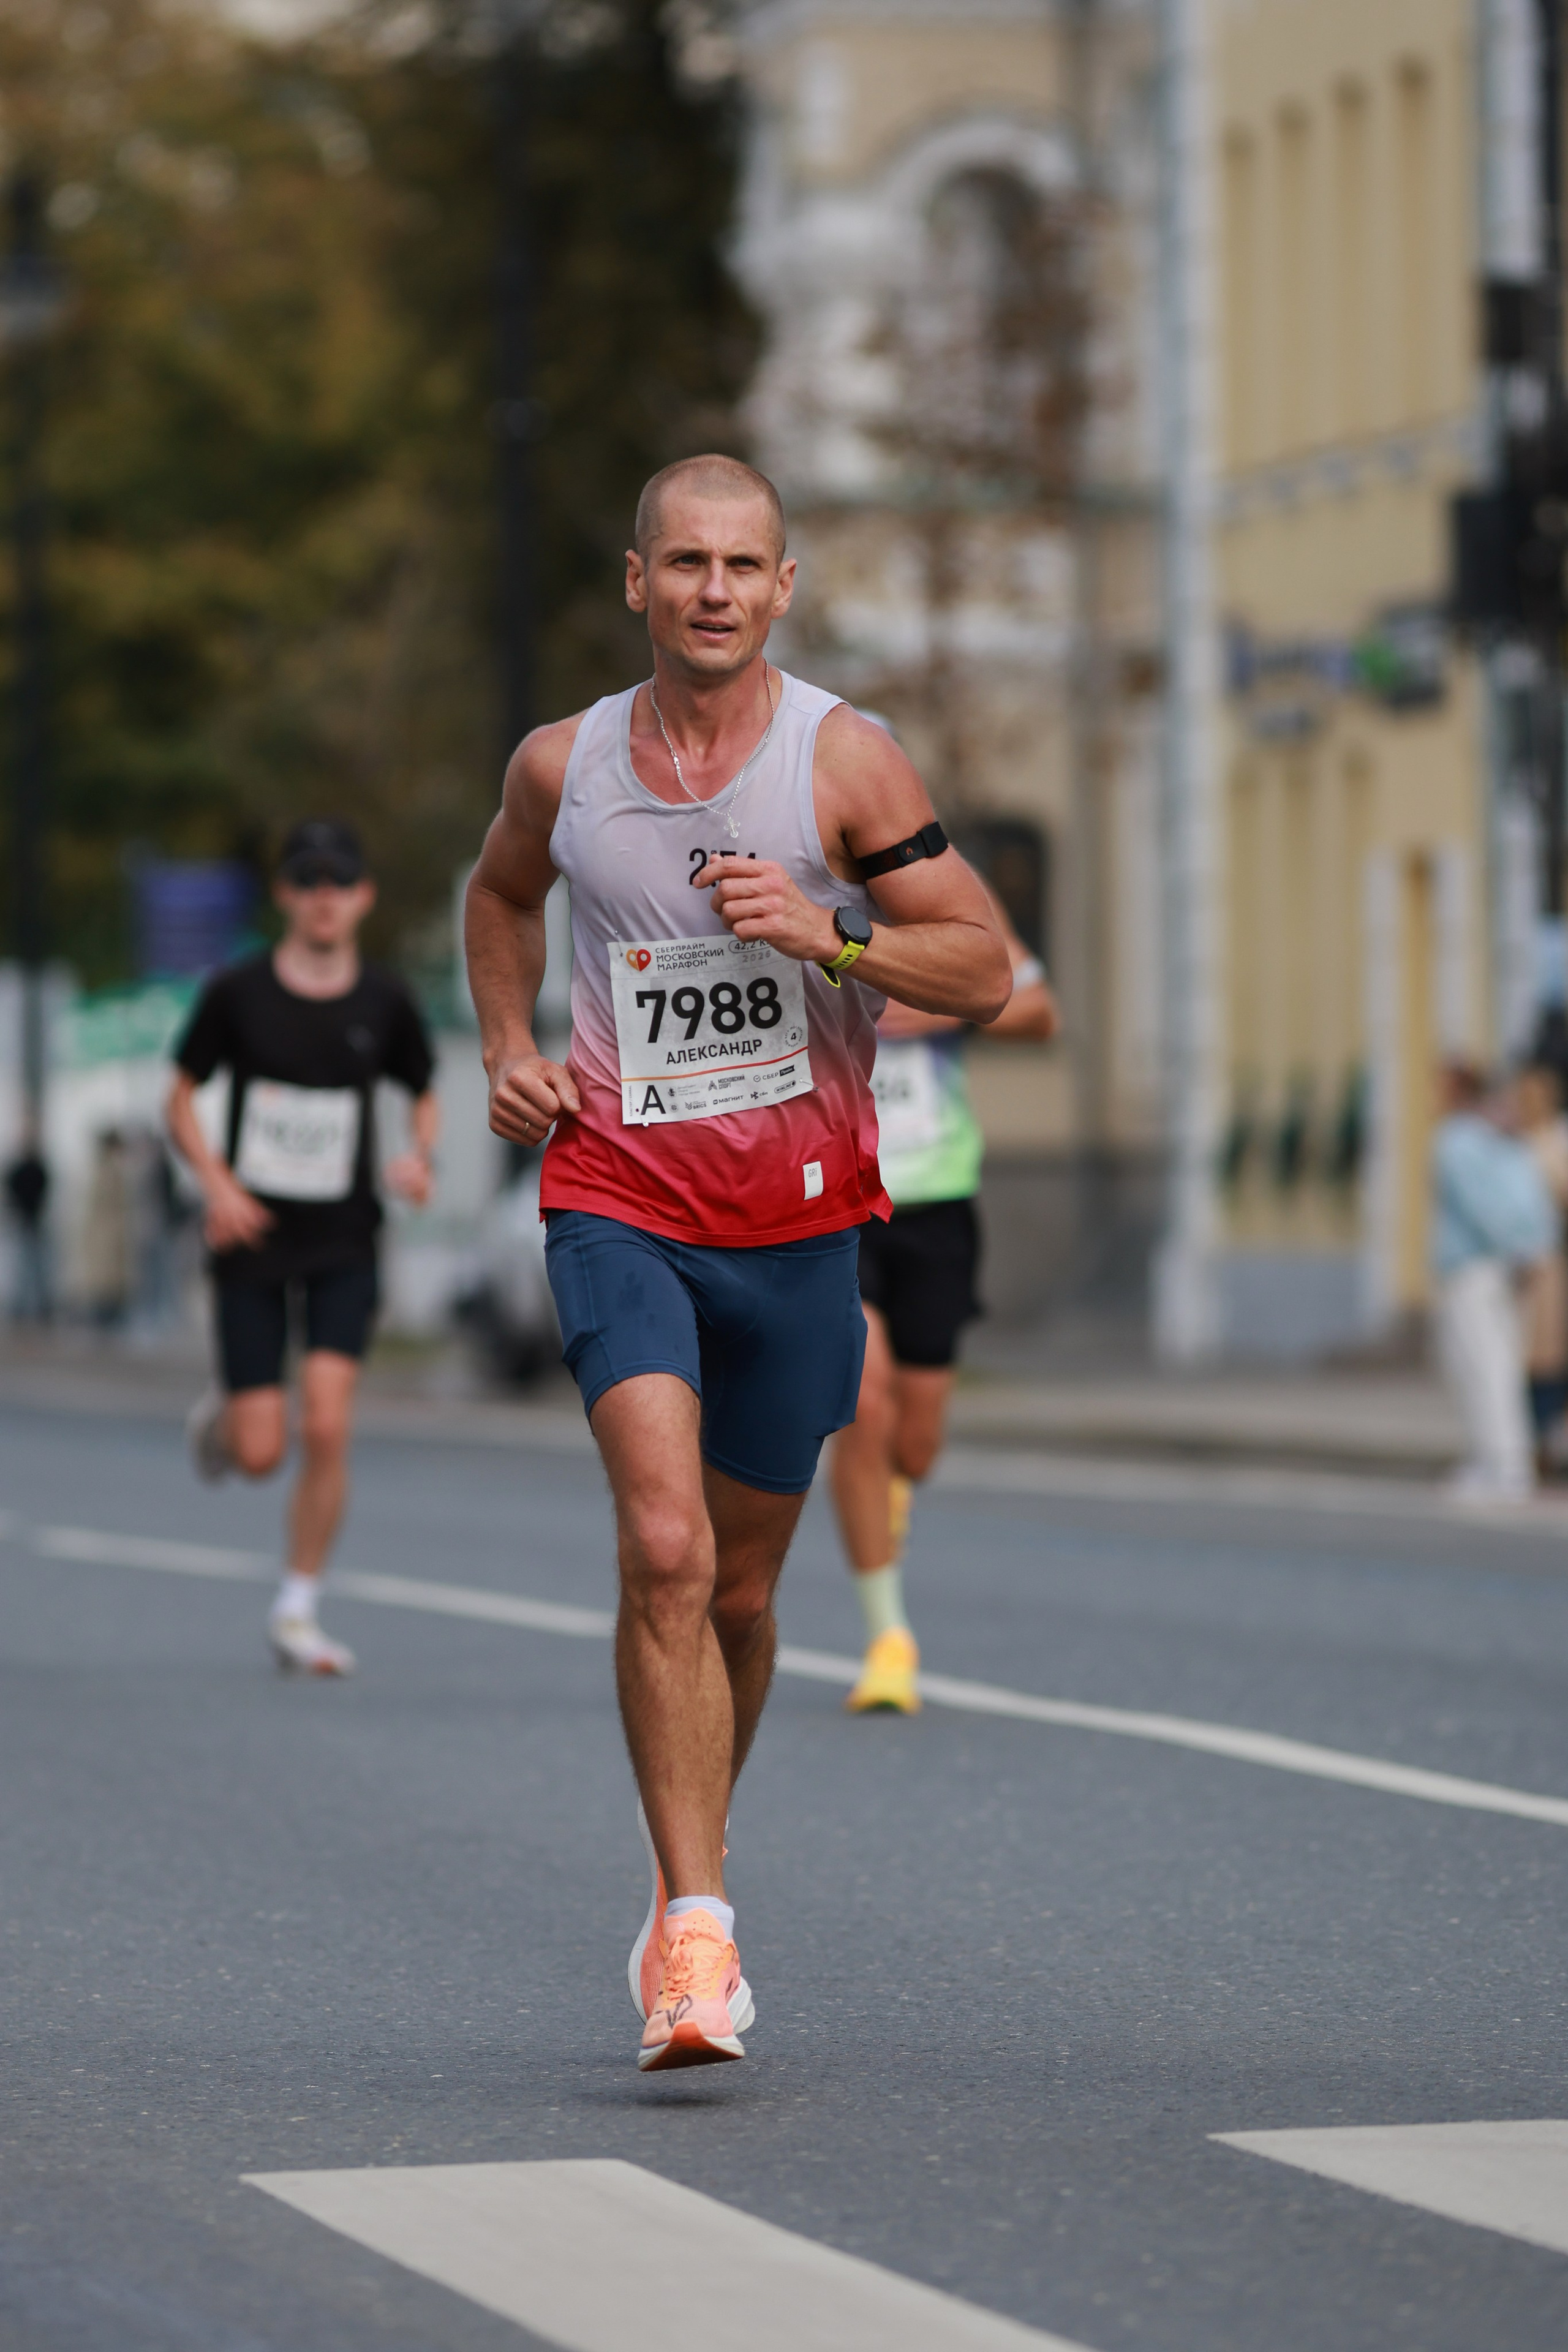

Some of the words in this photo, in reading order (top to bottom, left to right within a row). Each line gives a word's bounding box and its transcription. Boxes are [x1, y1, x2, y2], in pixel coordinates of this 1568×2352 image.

[655, 943, 706, 954] СБЕРПРАЙМ
[656, 949, 725, 963] МОСКОВСКИЙ
[657, 959, 708, 971] МАРАФОН
[635, 977, 782, 1043] 7988
[666, 1039, 763, 1065] АЛЕКСАНДР
[762, 1072, 779, 1080] СБЕР
